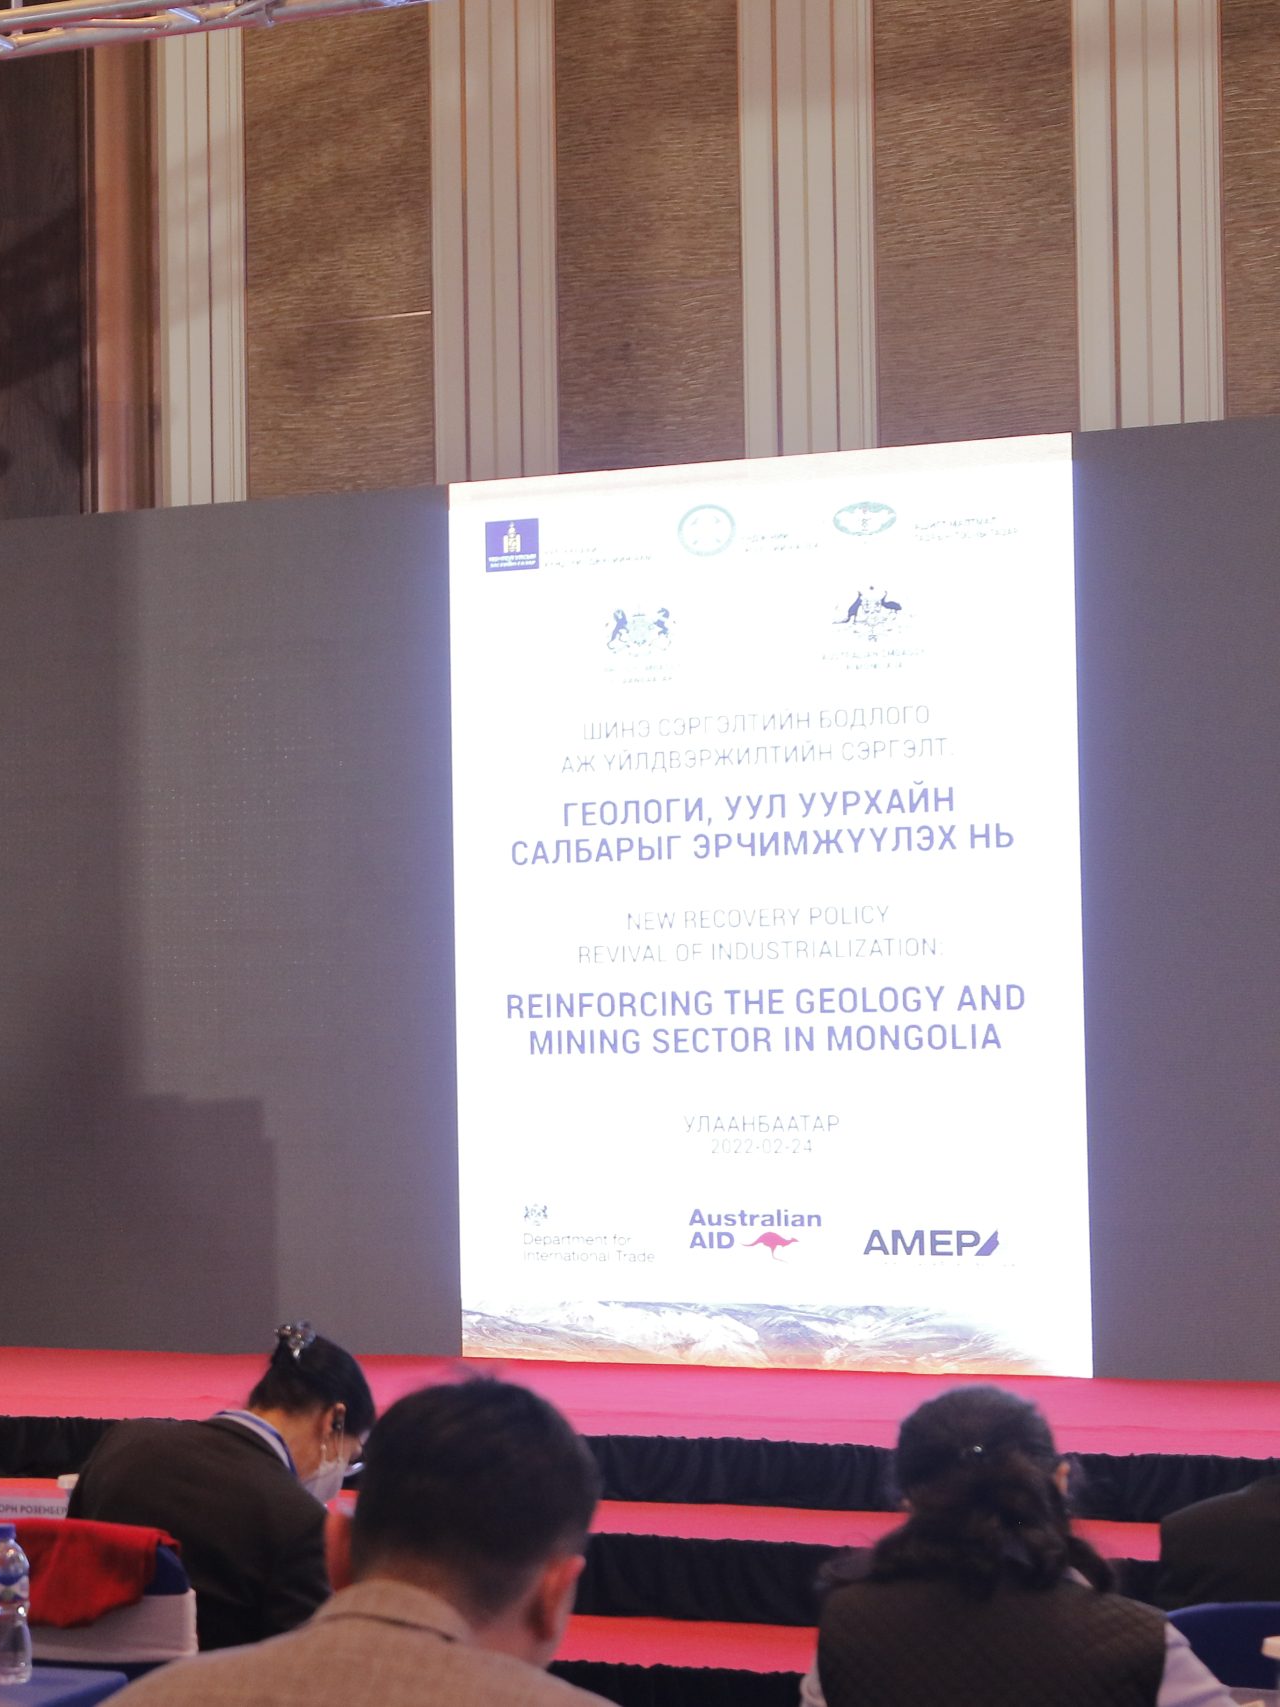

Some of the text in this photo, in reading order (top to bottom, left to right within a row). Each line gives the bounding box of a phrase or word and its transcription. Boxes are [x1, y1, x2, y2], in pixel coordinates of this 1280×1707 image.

[584, 705, 929, 740] ШИНЭ СЭРГЭЛТИЙН БОДЛОГО
[562, 755, 595, 773] АЖ
[564, 781, 953, 826] ГЕОЛОГИ, УУЛ УУРХАЙН
[512, 836, 681, 865] САЛБАРЫГ
[970, 823, 1014, 849] НЬ
[628, 906, 888, 930] NEW RECOVERY POLICY
[579, 945, 665, 963] REVIVAL
[675, 943, 702, 961] OF
[507, 984, 1024, 1019] REINFORCING THE GEOLOGY AND
[530, 1023, 1001, 1055] MINING SECTOR IN MONGOLIA
[685, 1115, 839, 1133] УЛААНБААТАР
[711, 1138, 813, 1154] 2022-02-24
[689, 1209, 821, 1227] Australian
[524, 1233, 631, 1247] Department for
[690, 1232, 734, 1249] AID
[863, 1230, 981, 1257] AMEP
[524, 1249, 655, 1262] International Trade
